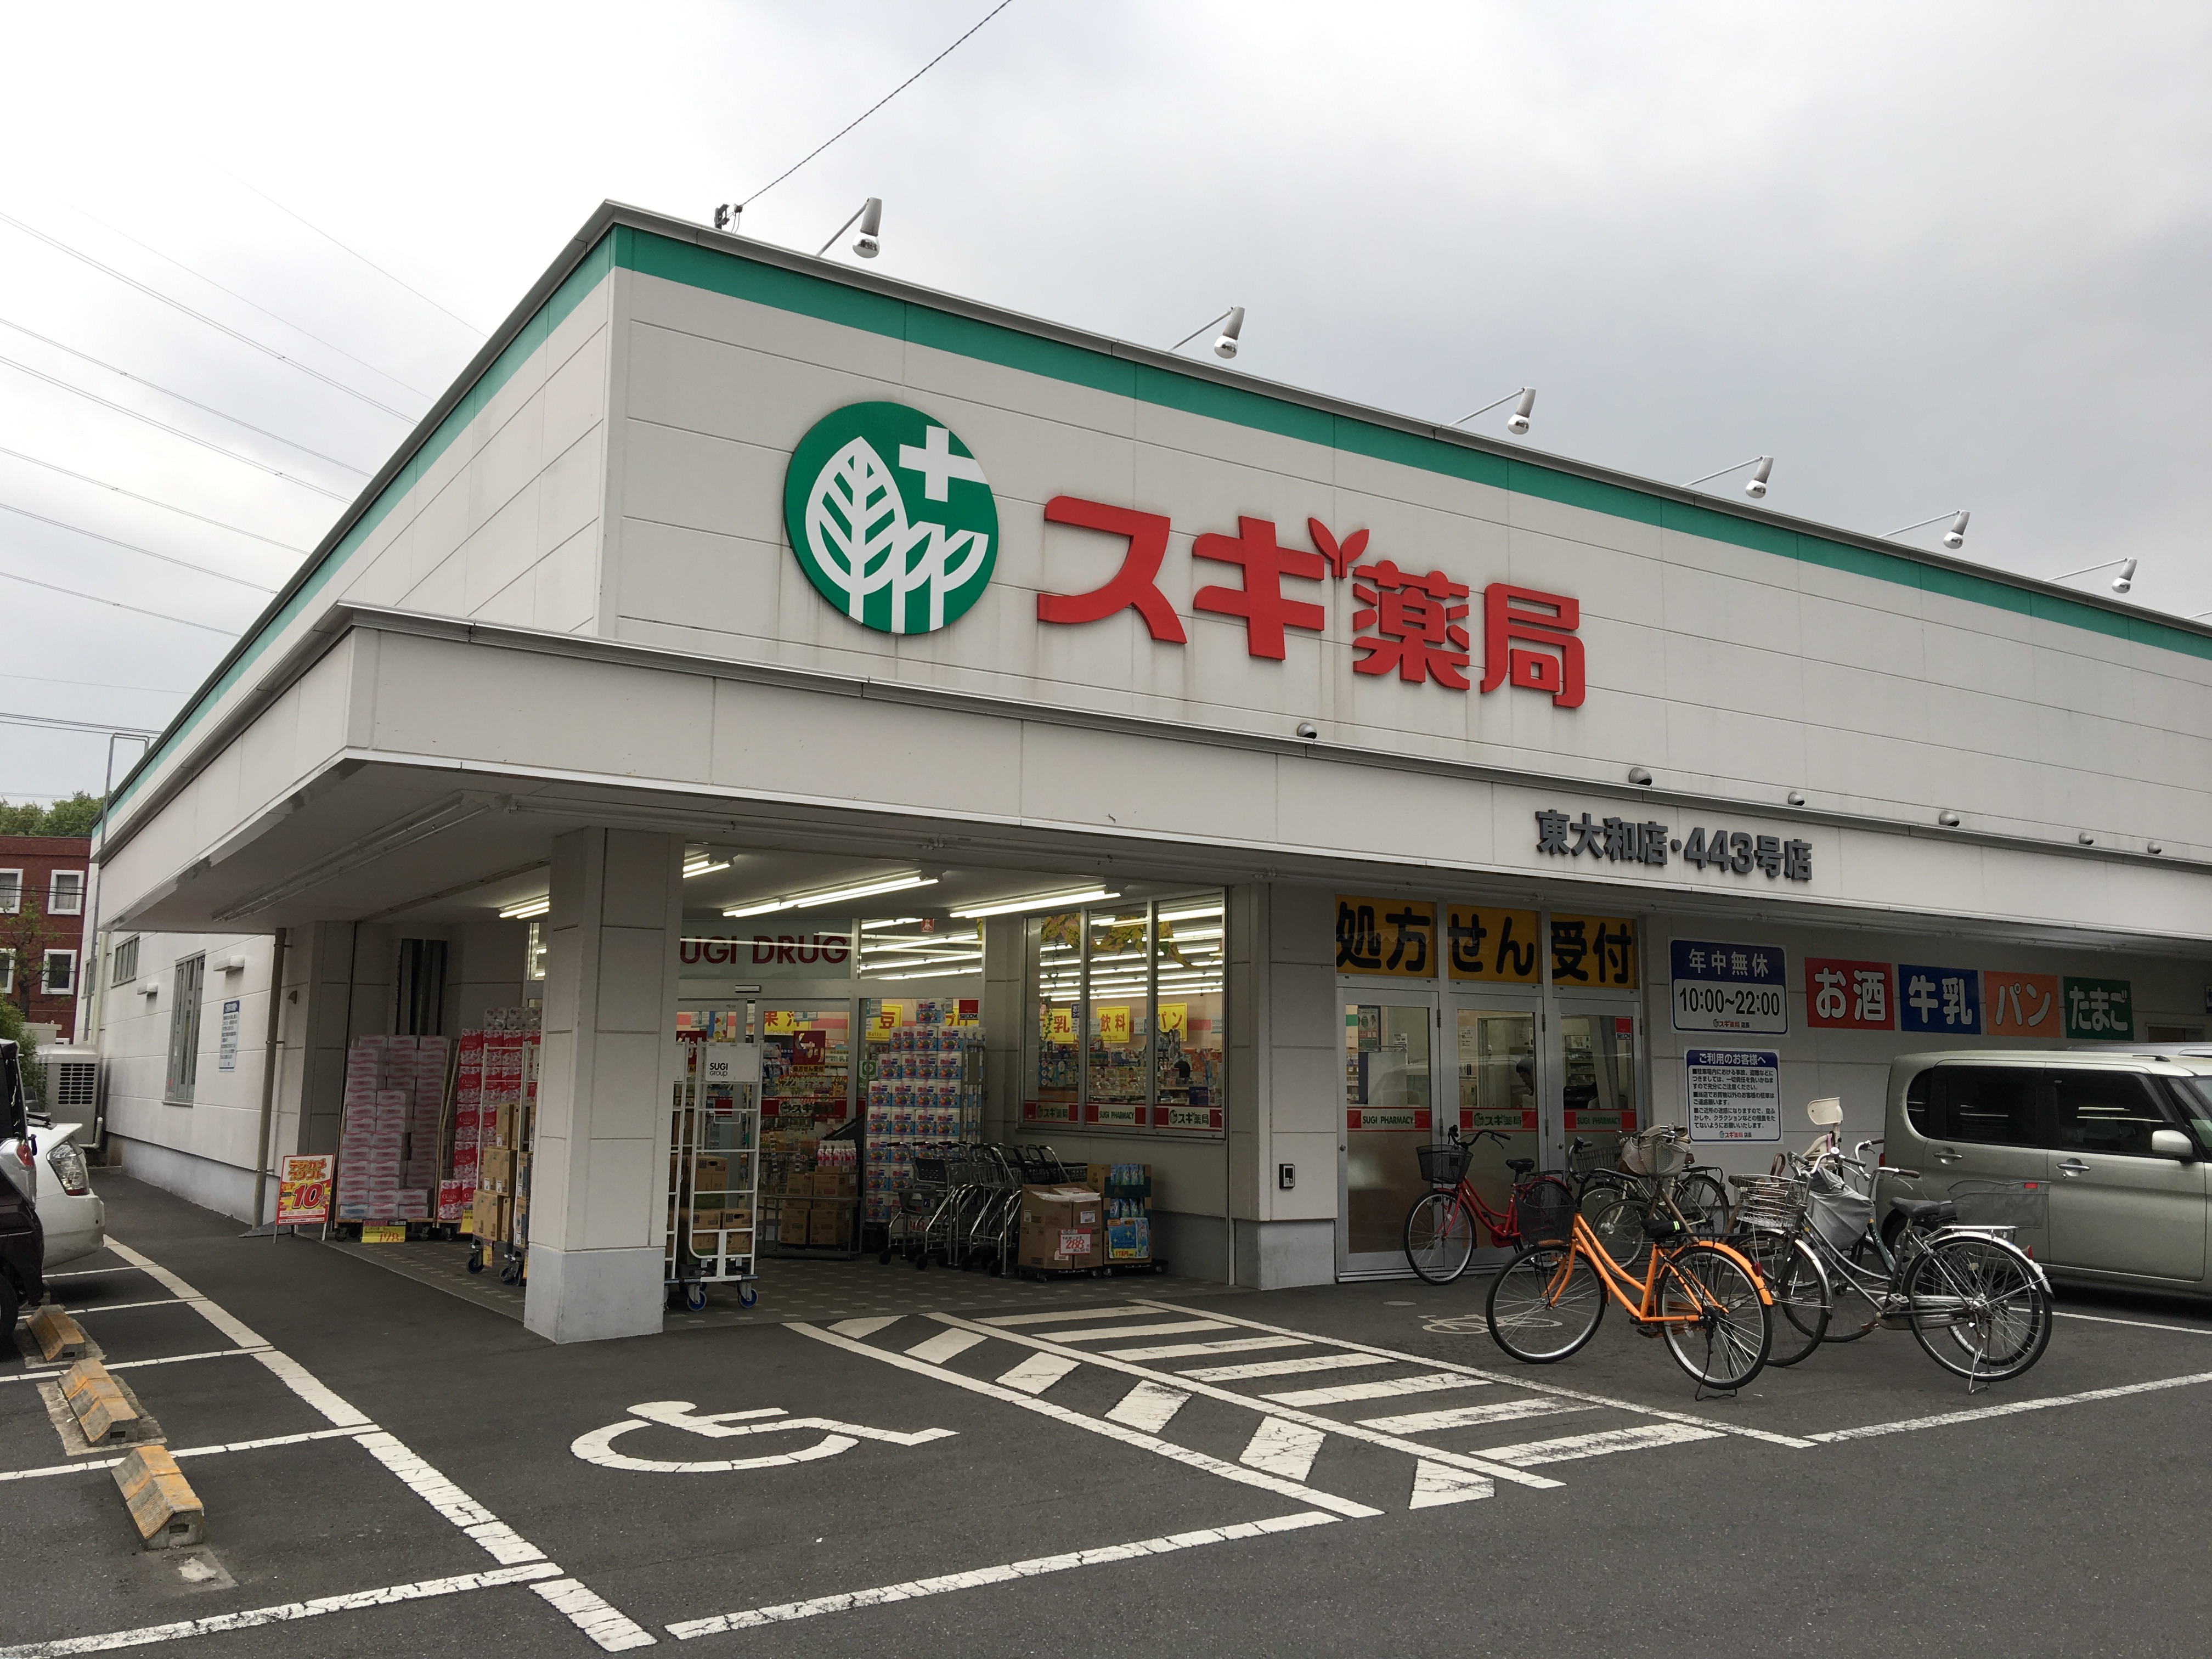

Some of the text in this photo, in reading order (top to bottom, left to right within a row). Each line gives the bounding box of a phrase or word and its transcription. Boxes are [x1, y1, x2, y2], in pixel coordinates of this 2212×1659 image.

[1037, 495, 1585, 708] スギ薬局
[752, 935, 849, 964] DRUG
[1336, 901, 1632, 984] 処方せん受付
[1689, 949, 1769, 978] 年中無休
[1815, 967, 1886, 1021] お酒
[1908, 974, 1973, 1025] 牛乳
[1995, 983, 2051, 1027] パン
[2069, 985, 2128, 1031] たまご
[1100, 1013, 1126, 1032] 飲料
[710, 1062, 729, 1070] SUGI
[1699, 1053, 1766, 1065] ご利用のお客様へ
[1099, 1110, 1135, 1120] SUGI PHARMACY
[1177, 1111, 1209, 1125] スギ薬局
[1362, 1115, 1414, 1125] SUGI PHARMACY
[1484, 1114, 1522, 1126] スギ薬局
[1577, 1116, 1621, 1125] SUGI PHARMACY
[292, 1183, 324, 1209] 10
[1065, 1239, 1085, 1249] 288
